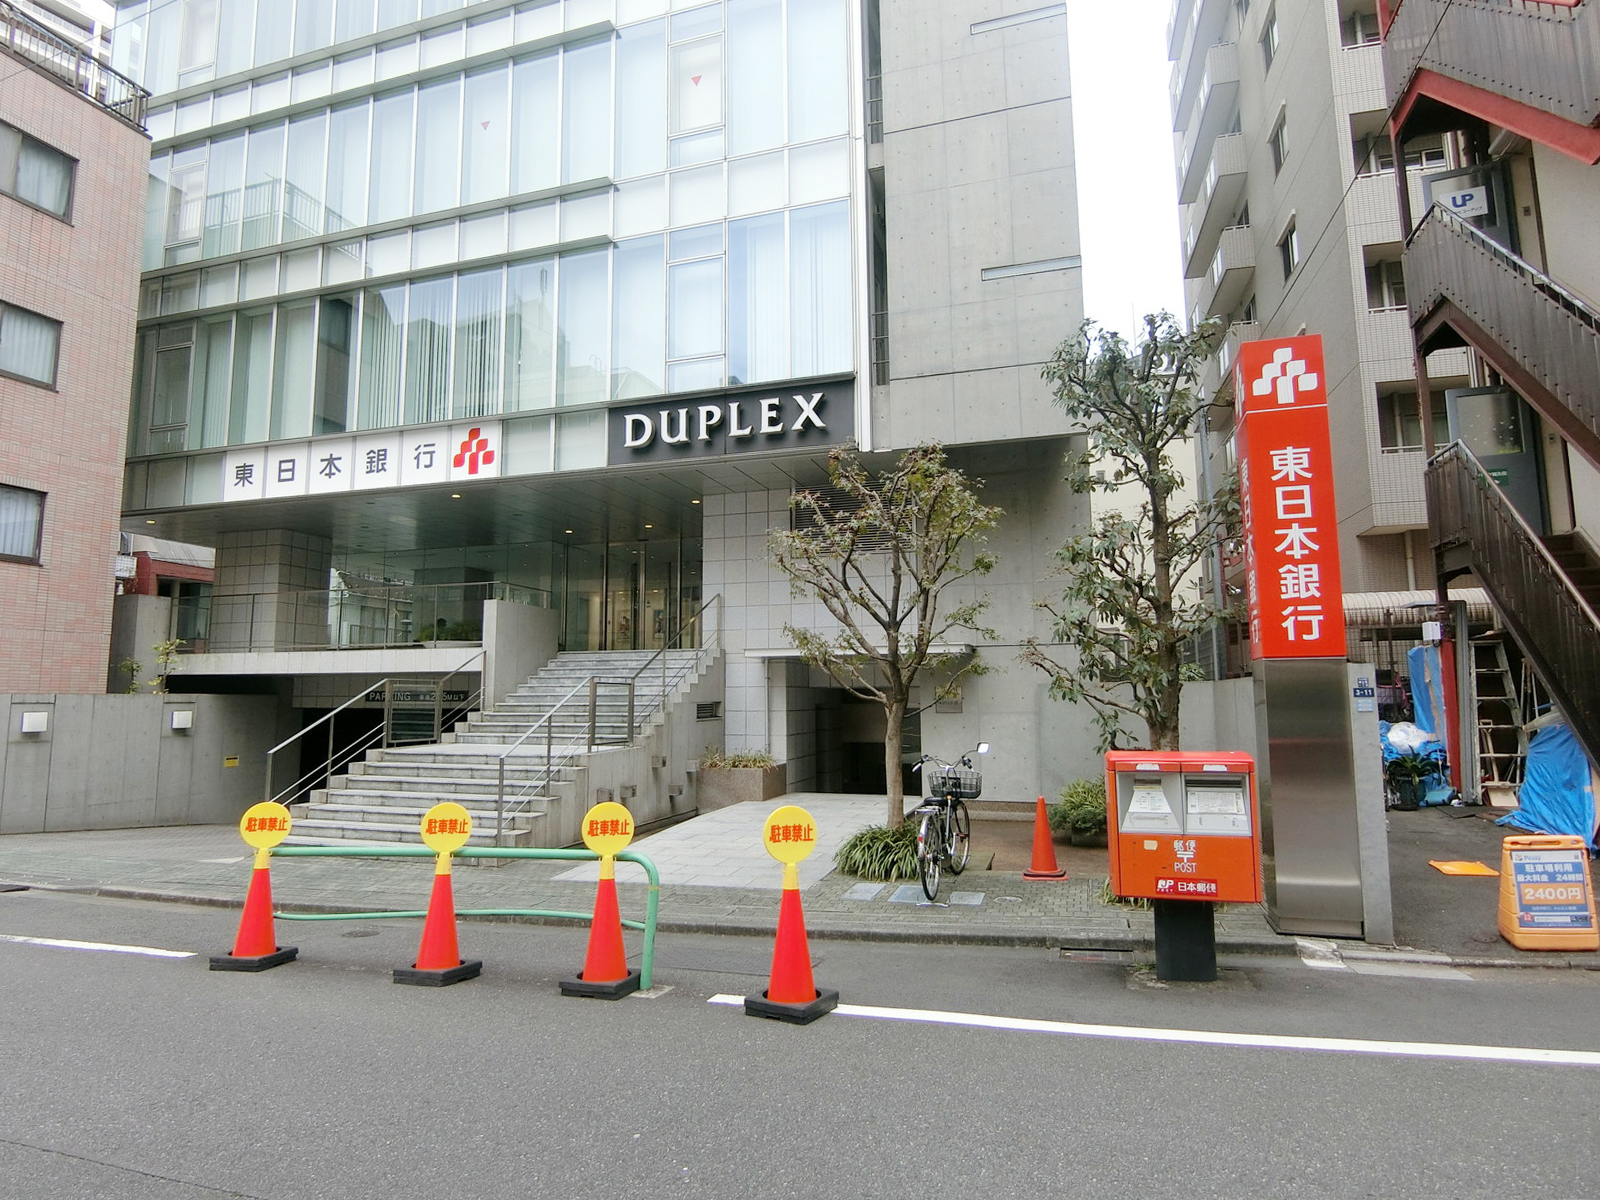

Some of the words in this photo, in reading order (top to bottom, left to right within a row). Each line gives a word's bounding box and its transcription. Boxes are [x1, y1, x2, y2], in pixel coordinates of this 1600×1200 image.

[1451, 193, 1474, 208] UP
[623, 392, 827, 449] DUPLEX
[234, 443, 436, 487] 東日本銀行
[1269, 446, 1324, 641] 東日本銀行
[369, 692, 411, 701] PARING
[245, 817, 288, 832] 駐車禁止
[426, 818, 468, 834] 駐車禁止
[587, 819, 630, 837] 駐車禁止
[769, 824, 813, 843] 駐車禁止
[1173, 840, 1196, 852] 郵便
[1174, 862, 1197, 873] POST
[1178, 882, 1216, 893] 日本郵便
[1524, 887, 1581, 900] 2400円
